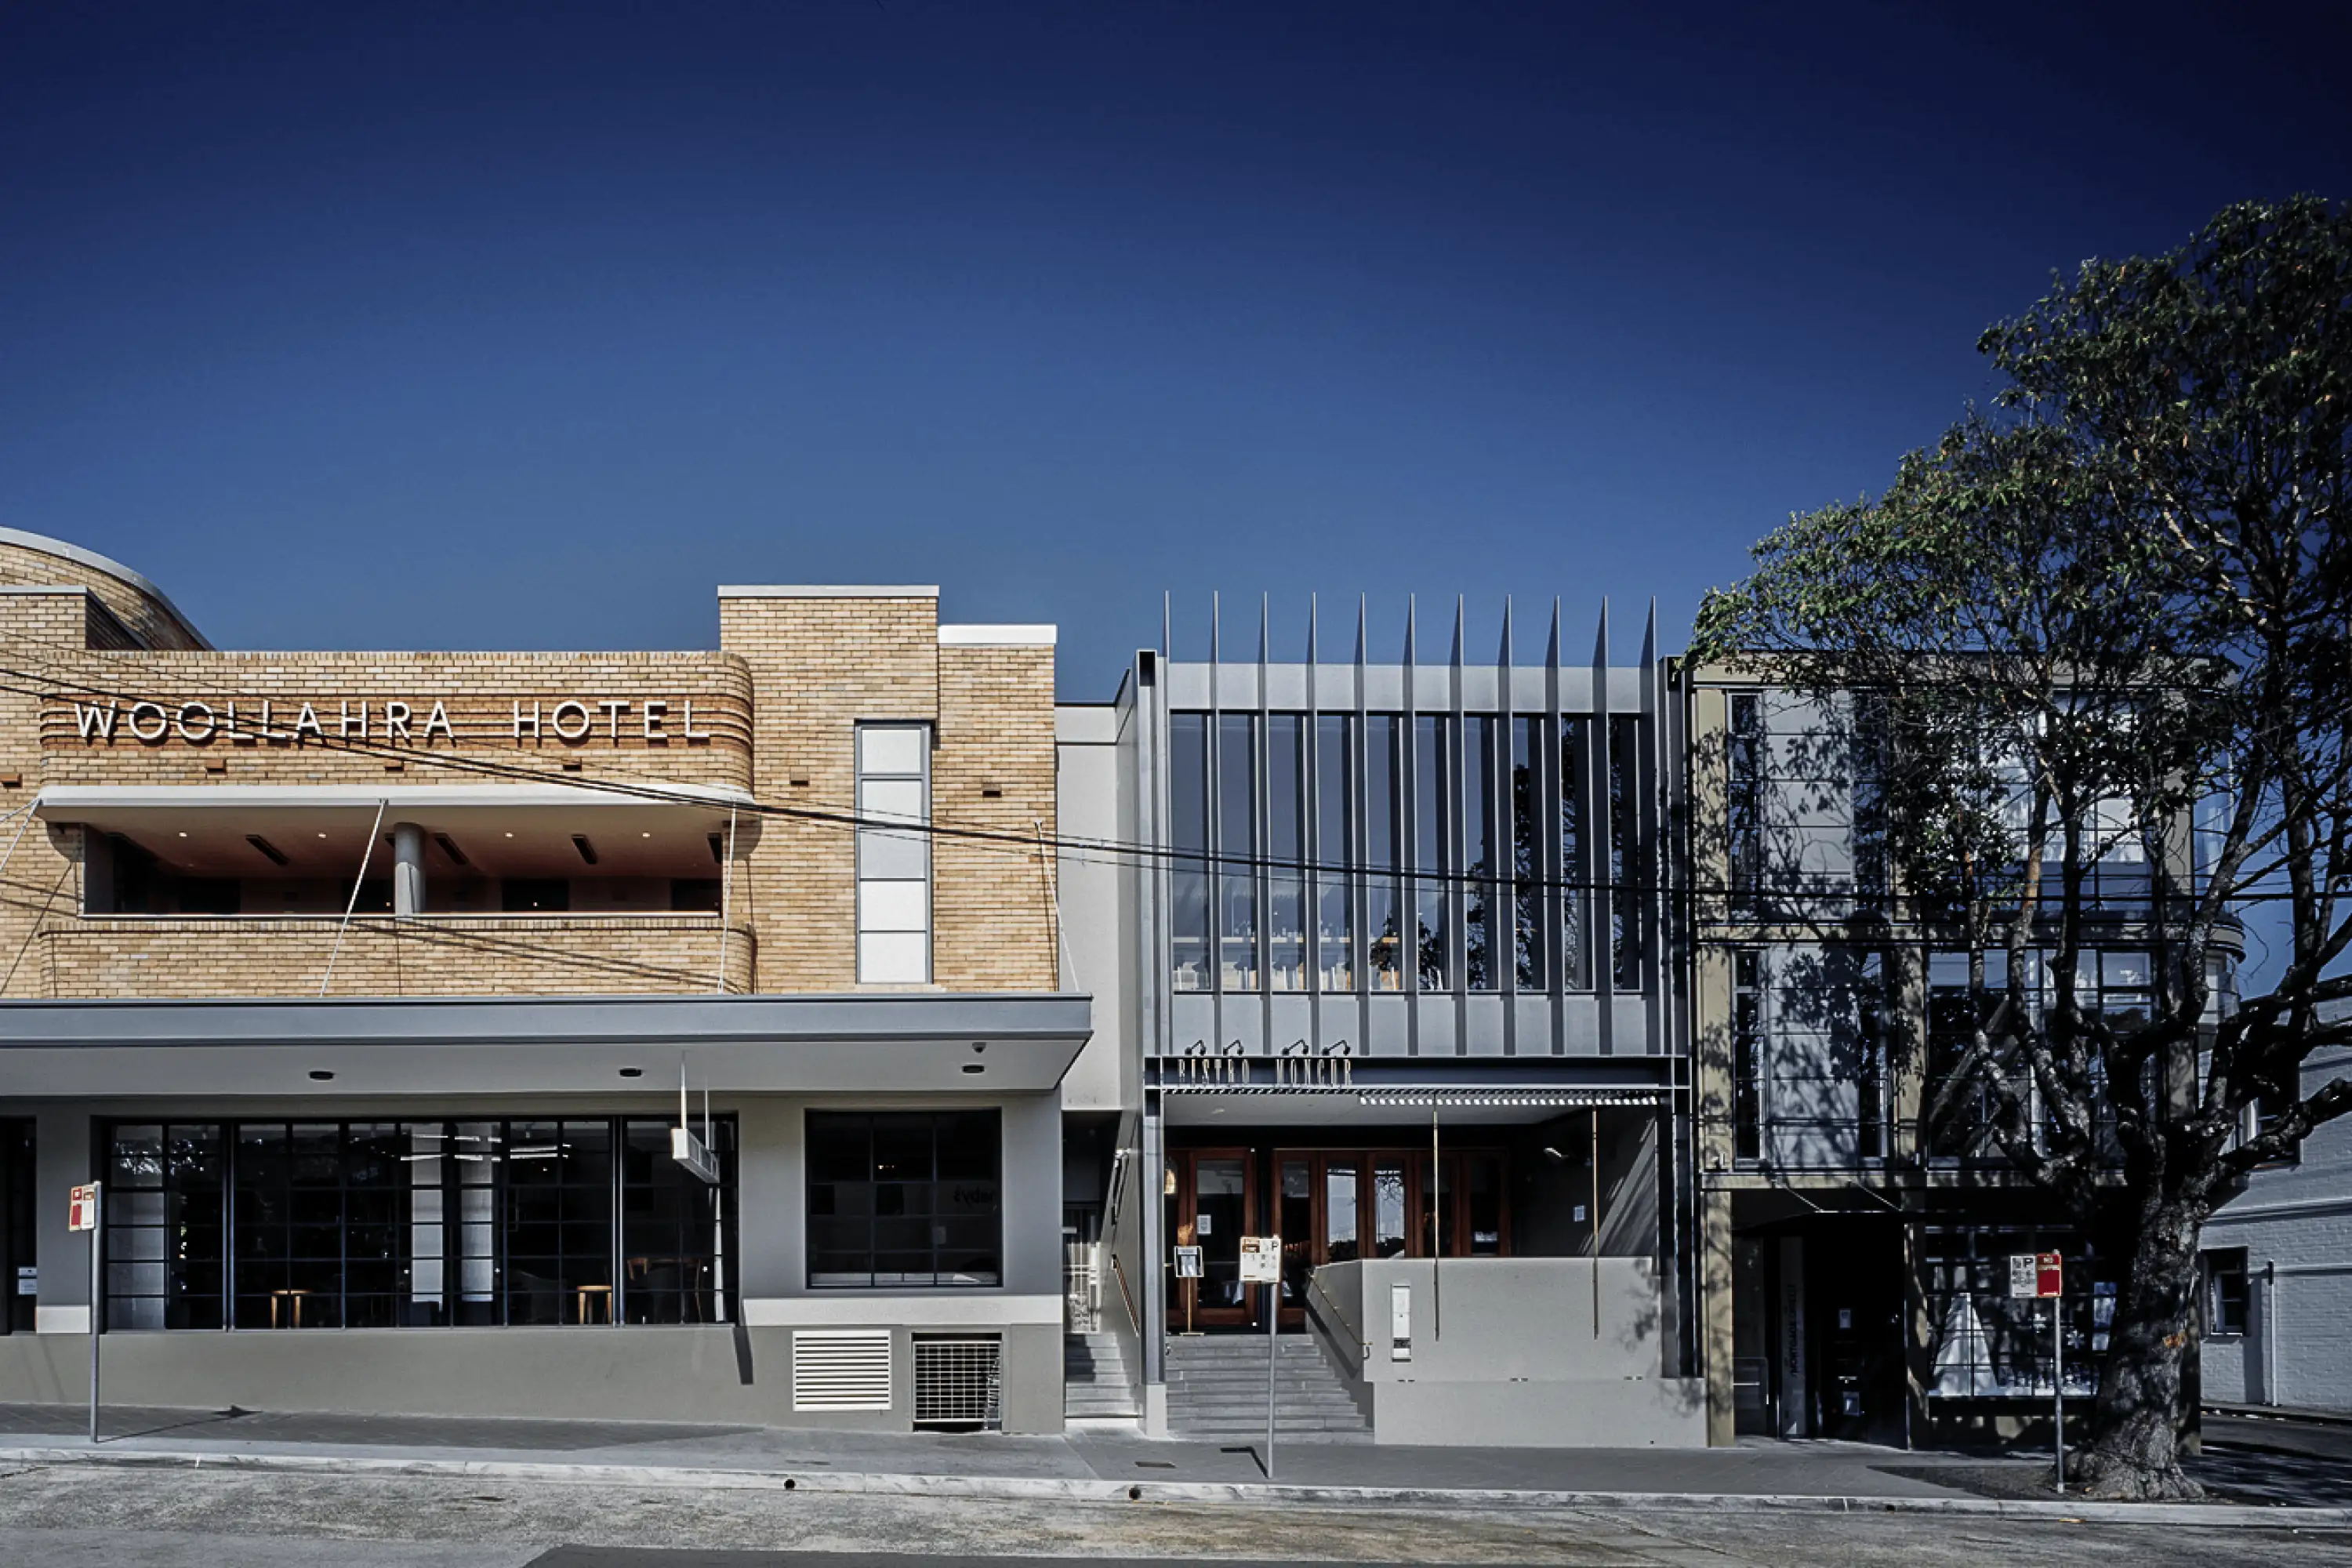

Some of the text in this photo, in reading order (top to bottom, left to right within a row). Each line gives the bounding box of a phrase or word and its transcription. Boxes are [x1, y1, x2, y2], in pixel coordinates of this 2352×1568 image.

[75, 699, 710, 740] WOOLLAHRA HOTEL
[1178, 1058, 1250, 1085] BISTRO
